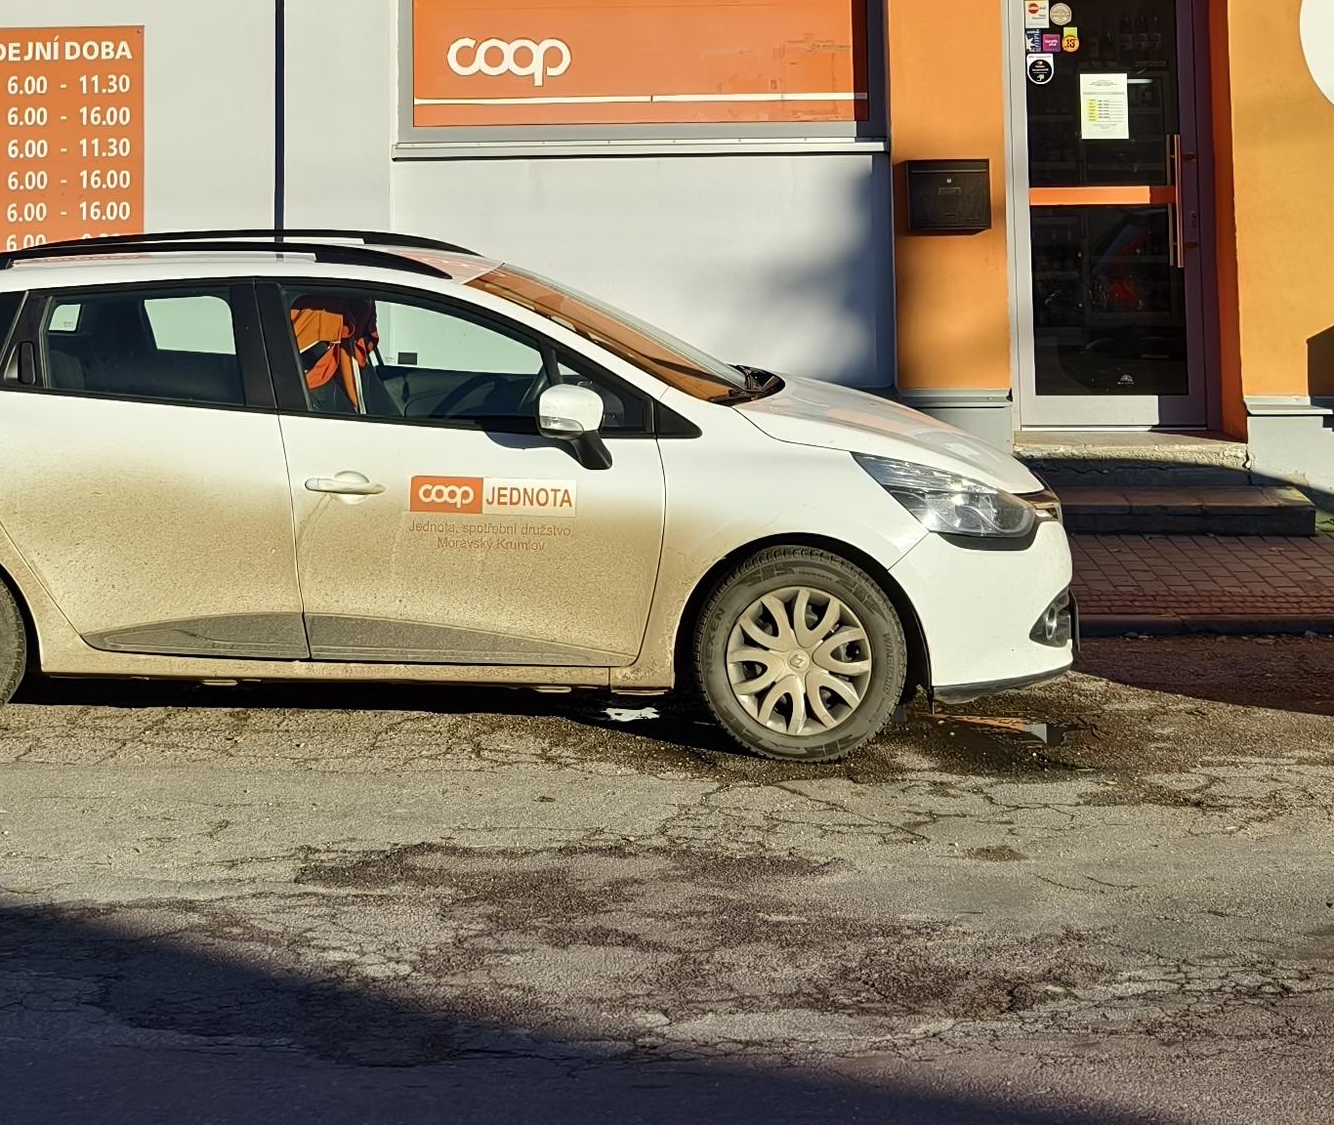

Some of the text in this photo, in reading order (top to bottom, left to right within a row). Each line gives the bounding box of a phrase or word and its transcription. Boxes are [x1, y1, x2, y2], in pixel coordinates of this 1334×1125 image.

[64, 40, 133, 61] DOBA
[446, 37, 572, 87] coop
[6, 75, 48, 95] 6.00
[78, 74, 131, 94] 11.30
[6, 106, 48, 126] 6.00
[78, 106, 131, 126] 16.00
[6, 139, 48, 159] 6.00
[78, 137, 131, 157] 11.30
[6, 170, 48, 190] 6.00
[78, 169, 131, 189] 16.00
[6, 202, 48, 223] 6.00
[78, 201, 131, 221] 16.00
[6, 233, 47, 252] 600
[418, 483, 573, 509] coop JEDNOTA
[408, 520, 460, 535] Jednota,
[464, 522, 517, 536] spotřební
[436, 536, 546, 552] Moravský Krumlov
[705, 607, 726, 675] NEXEN
